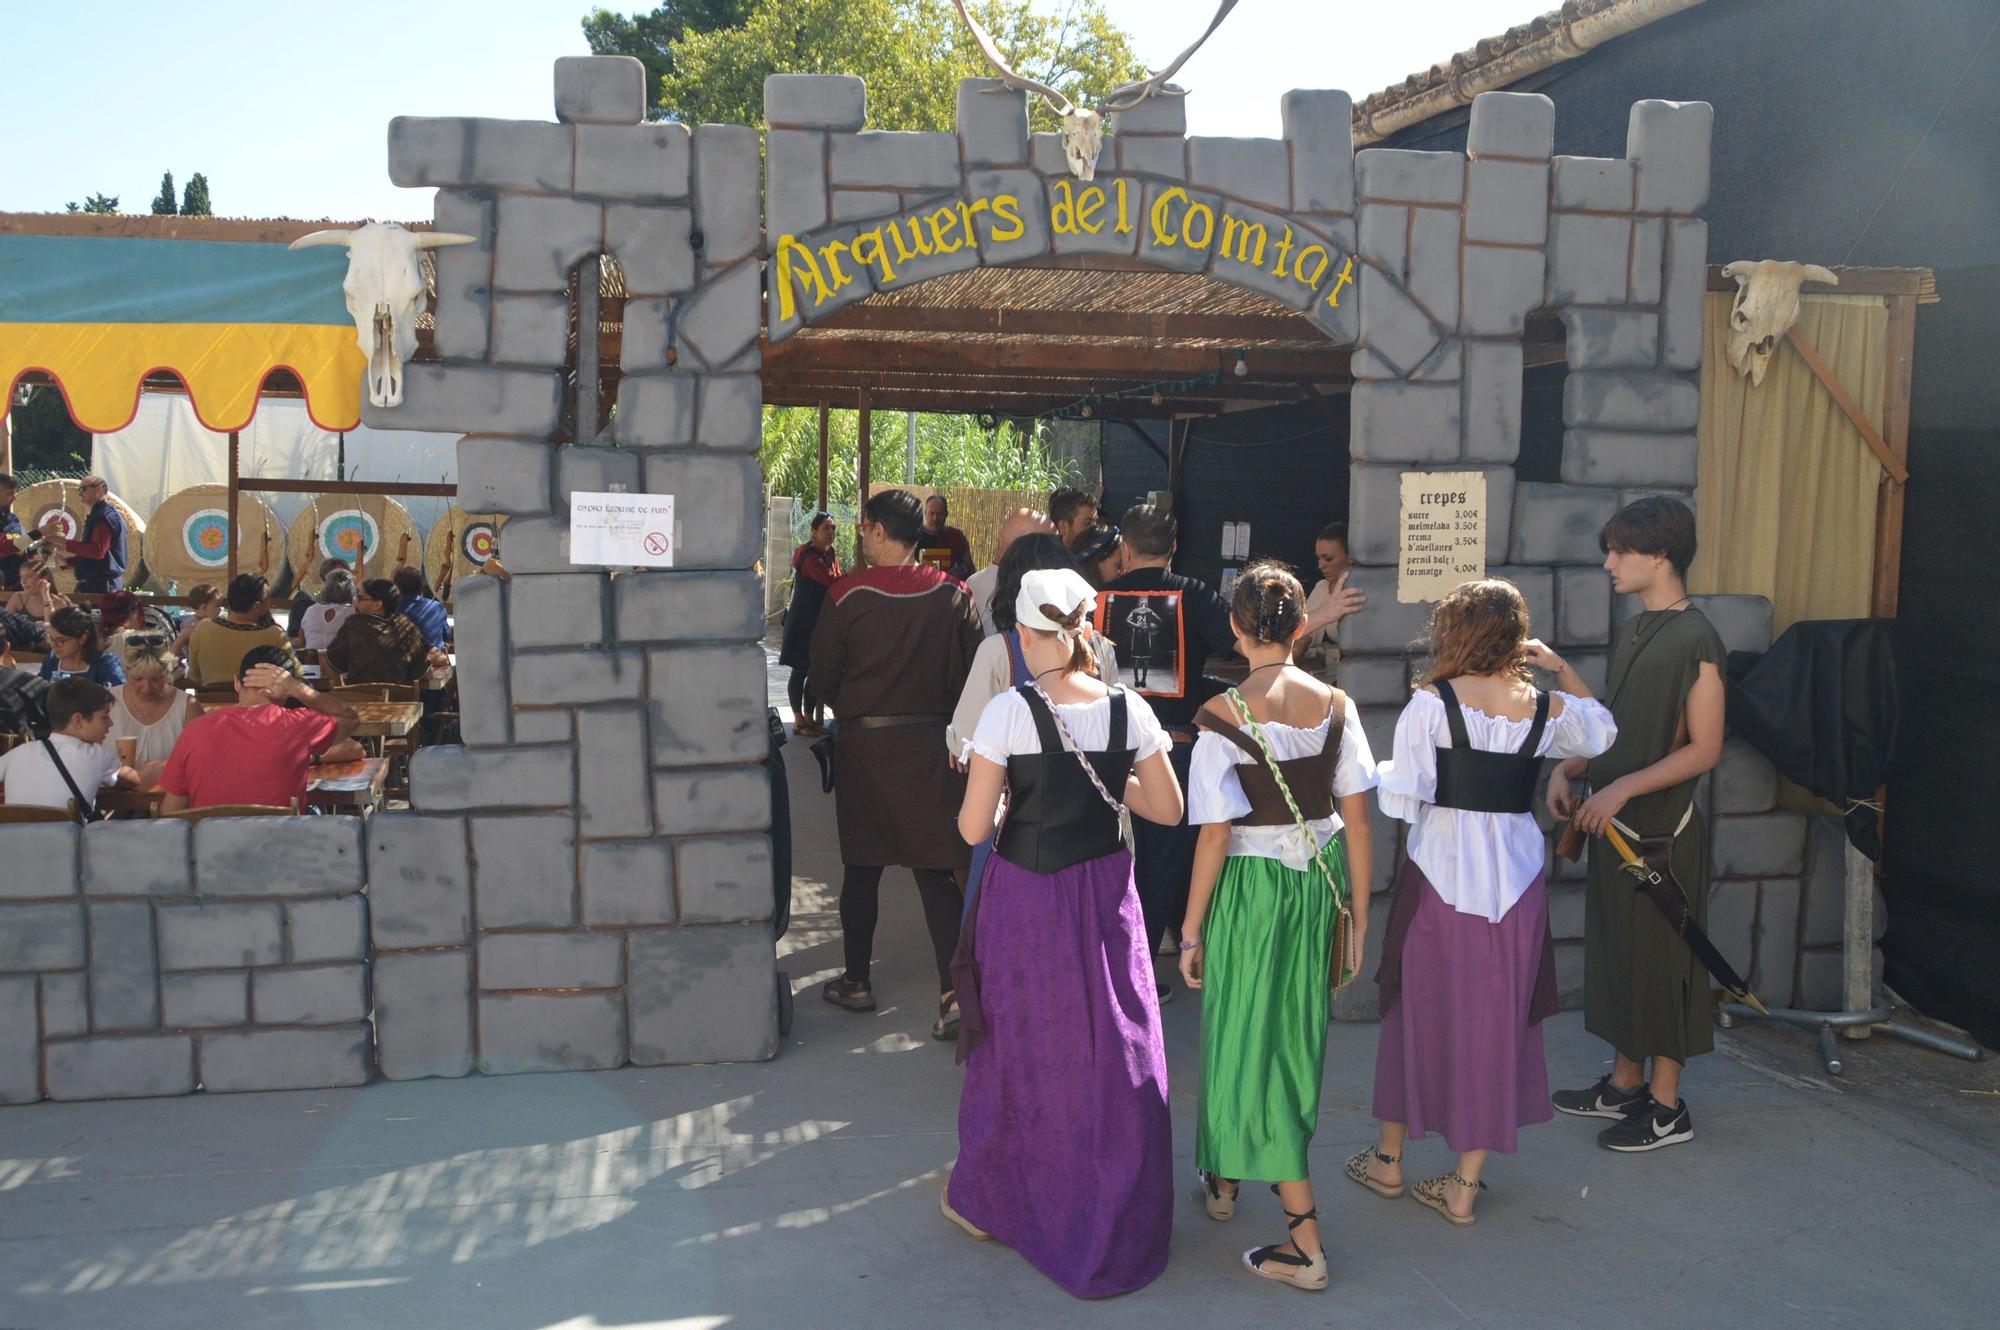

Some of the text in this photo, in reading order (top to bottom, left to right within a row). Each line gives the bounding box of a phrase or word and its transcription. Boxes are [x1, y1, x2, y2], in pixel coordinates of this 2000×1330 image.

[777, 179, 1353, 321] Arquers del Comtat
[1420, 490, 1467, 507] crepes
[1408, 512, 1430, 520] sucre
[1408, 534, 1432, 542] crema
[1407, 555, 1431, 565] pernil
[1406, 567, 1443, 577] formatge
[1136, 615, 1147, 625] 24
